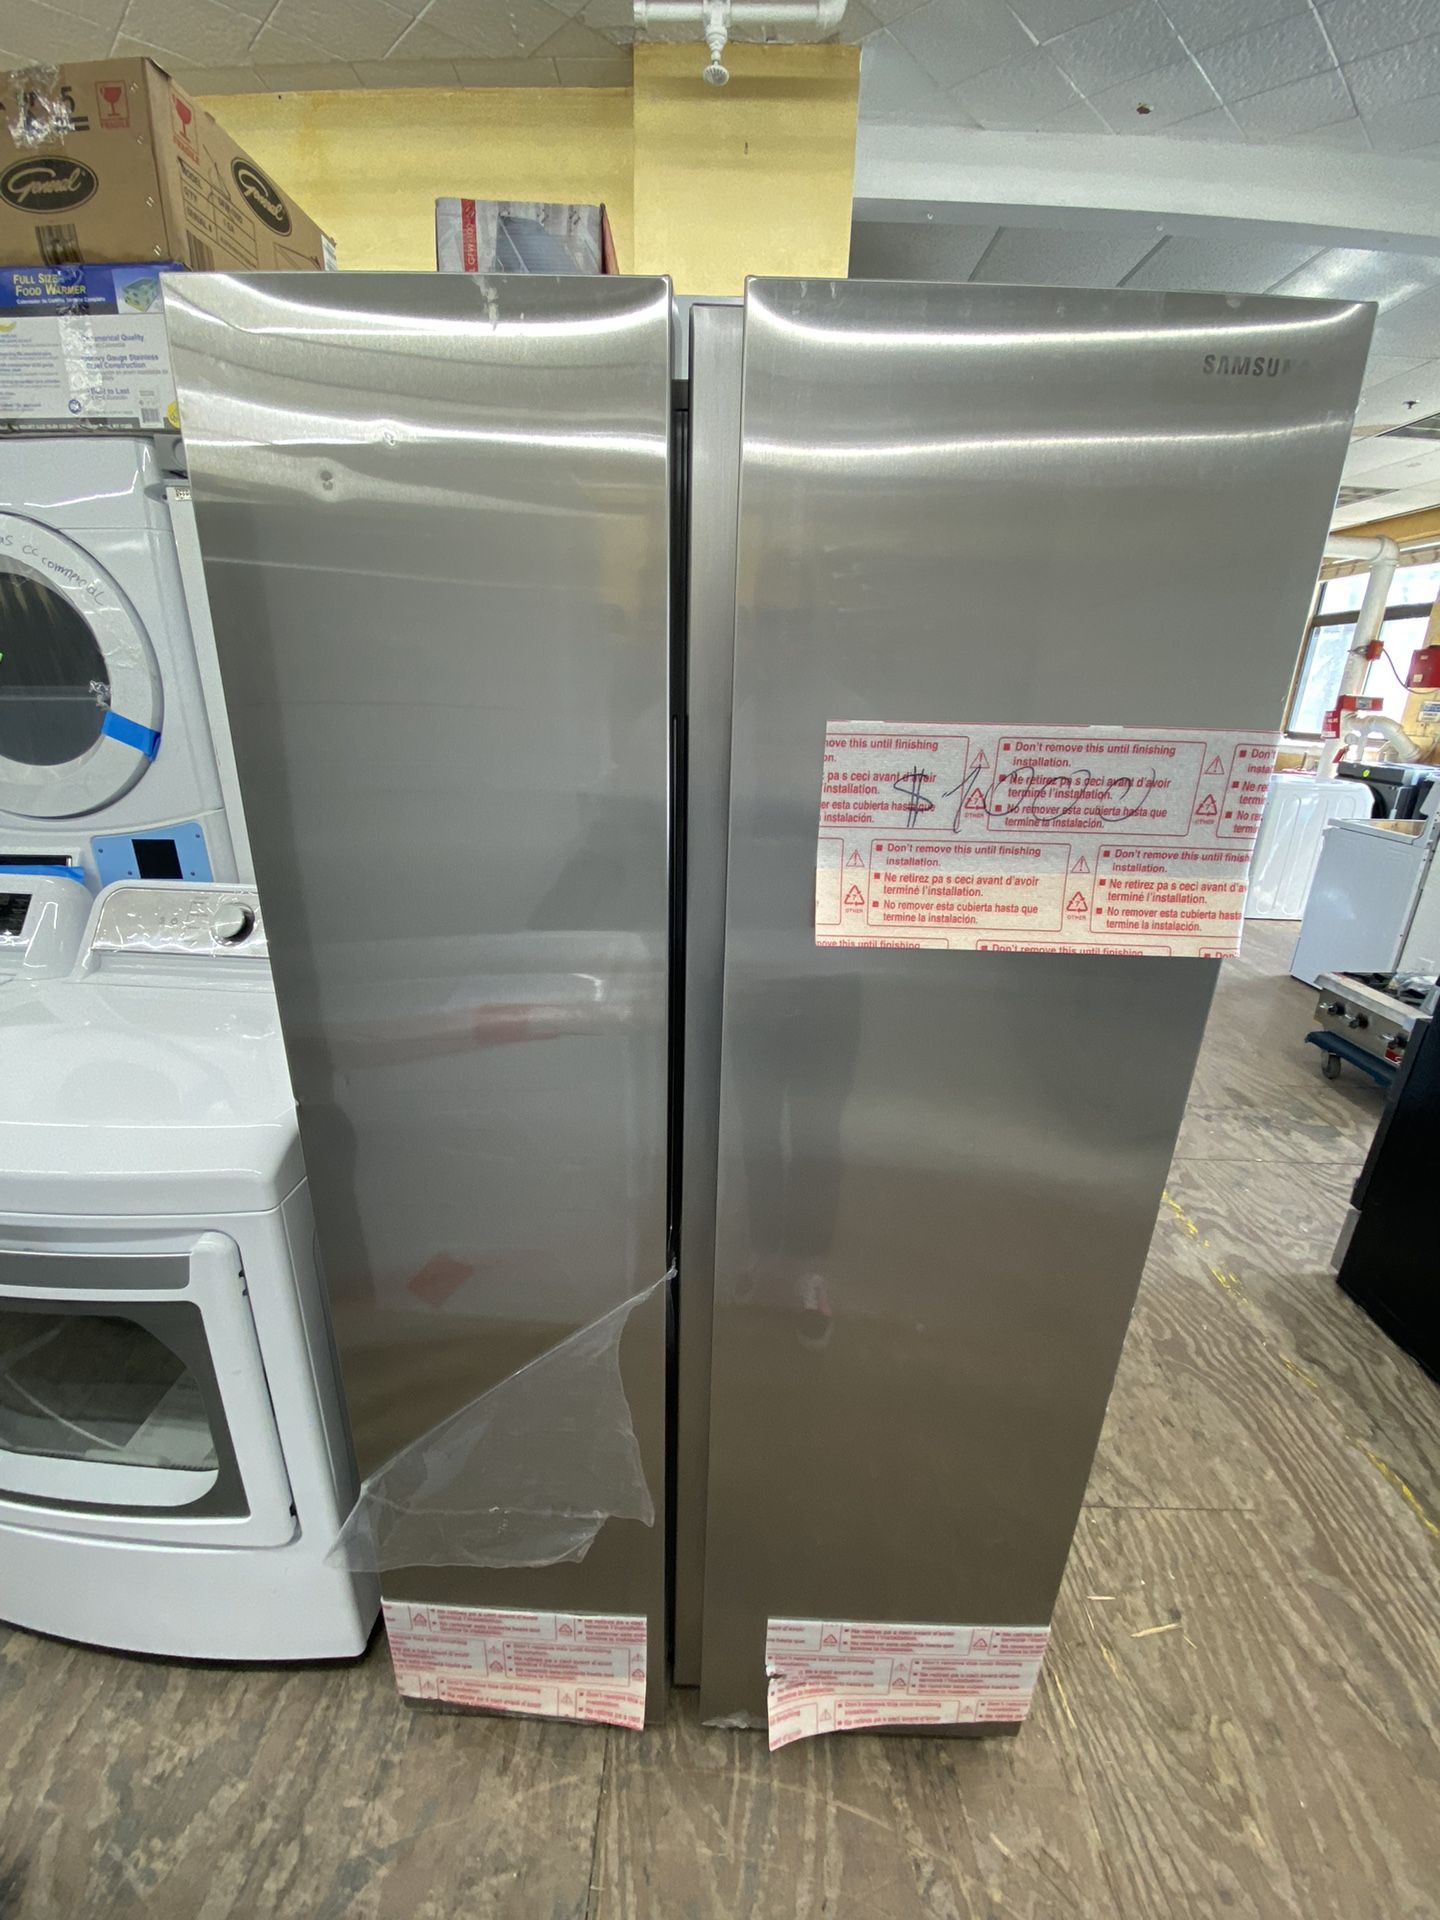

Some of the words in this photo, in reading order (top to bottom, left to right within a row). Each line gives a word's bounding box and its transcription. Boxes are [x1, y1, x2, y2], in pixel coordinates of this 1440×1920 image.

[13, 273, 36, 285] FULL
[15, 285, 42, 297] FOOD
[45, 284, 86, 296] WARMER
[849, 738, 867, 749] this
[870, 739, 892, 750] until
[895, 739, 939, 752] finishing
[1015, 741, 1043, 751] Don't
[1045, 744, 1083, 754] remove
[1085, 743, 1106, 754] this
[1108, 744, 1130, 755] until
[1132, 745, 1176, 758] finishing
[1013, 757, 1072, 768] installation.
[850, 771, 871, 782] ceci
[873, 773, 901, 783] avant
[1026, 775, 1057, 786] retirez
[1084, 775, 1104, 787] ceci
[1107, 777, 1135, 788] avant
[1136, 776, 1171, 789] d'avoir
[1242, 781, 1255, 791] Ne
[832, 801, 851, 811] esta
[852, 801, 890, 812] cubierta
[891, 802, 917, 812] hasta
[1022, 804, 1061, 814] remover
[1062, 806, 1081, 817] esta
[1083, 806, 1120, 818] cubierta
[1123, 808, 1148, 819] hasta
[1150, 809, 1167, 820] que
[1005, 817, 1040, 827] termine
[1236, 810, 1249, 821] No
[887, 842, 913, 853] Don't
[915, 844, 952, 854] remove
[954, 843, 972, 855] this
[975, 845, 996, 855] until
[999, 846, 1041, 858] finishing
[1114, 848, 1142, 859] Don't
[1142, 850, 1179, 860] remove
[1181, 850, 1200, 861] this
[1201, 851, 1223, 862] until
[886, 857, 941, 867] installation.
[1112, 862, 1169, 873] installation.
[884, 872, 896, 883] Ne
[899, 872, 929, 884] retirez
[954, 874, 975, 885] ceci
[976, 876, 1004, 886] avant
[1005, 876, 1039, 887] d'avoir
[1108, 878, 1122, 890] Ne
[1124, 879, 1154, 890] retirez
[1179, 880, 1199, 892] ceci
[1200, 882, 1228, 893] avant
[921, 885, 984, 897] l'installation.
[1107, 891, 1145, 902] terminé
[1146, 891, 1208, 905] l'installation.
[884, 899, 895, 910] No
[898, 901, 933, 911] remover
[936, 901, 955, 912] esta
[957, 901, 993, 913] cubierta
[995, 903, 1020, 914] hasta
[1021, 904, 1039, 915] que
[1106, 906, 1119, 917] No
[1121, 907, 1158, 918] remover
[1160, 908, 1178, 918] esta
[1180, 908, 1217, 920] cubierta
[883, 912, 916, 922] termine
[918, 913, 927, 923] la
[927, 913, 978, 925] instalación.
[1106, 919, 1140, 930] termine
[1141, 919, 1150, 930] la
[1151, 920, 1203, 932] instalación.
